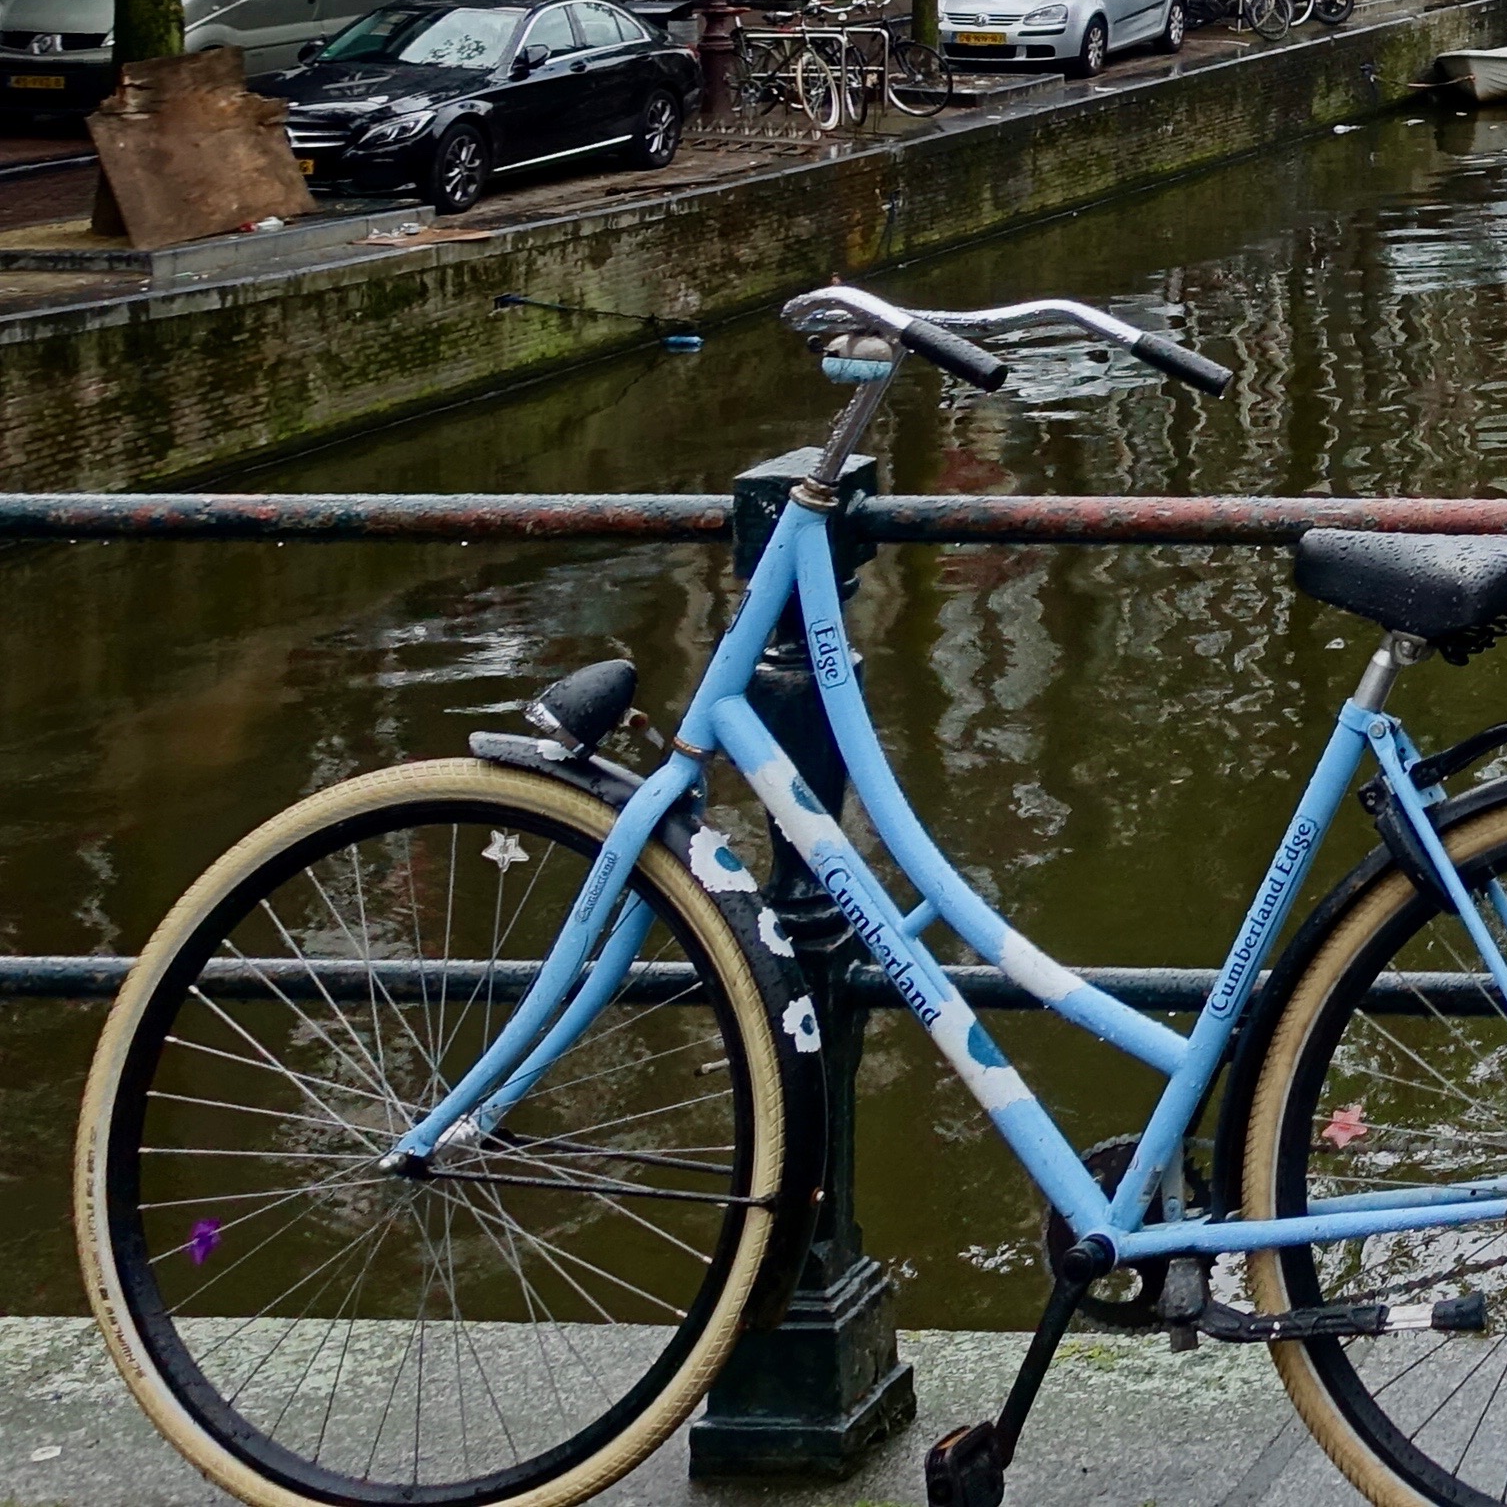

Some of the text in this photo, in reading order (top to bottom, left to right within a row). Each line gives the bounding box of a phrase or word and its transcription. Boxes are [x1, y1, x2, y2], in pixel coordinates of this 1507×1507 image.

[813, 626, 840, 682] Edge
[824, 866, 942, 1027] Cumberland
[1210, 822, 1312, 1012] Cumberland Edge
